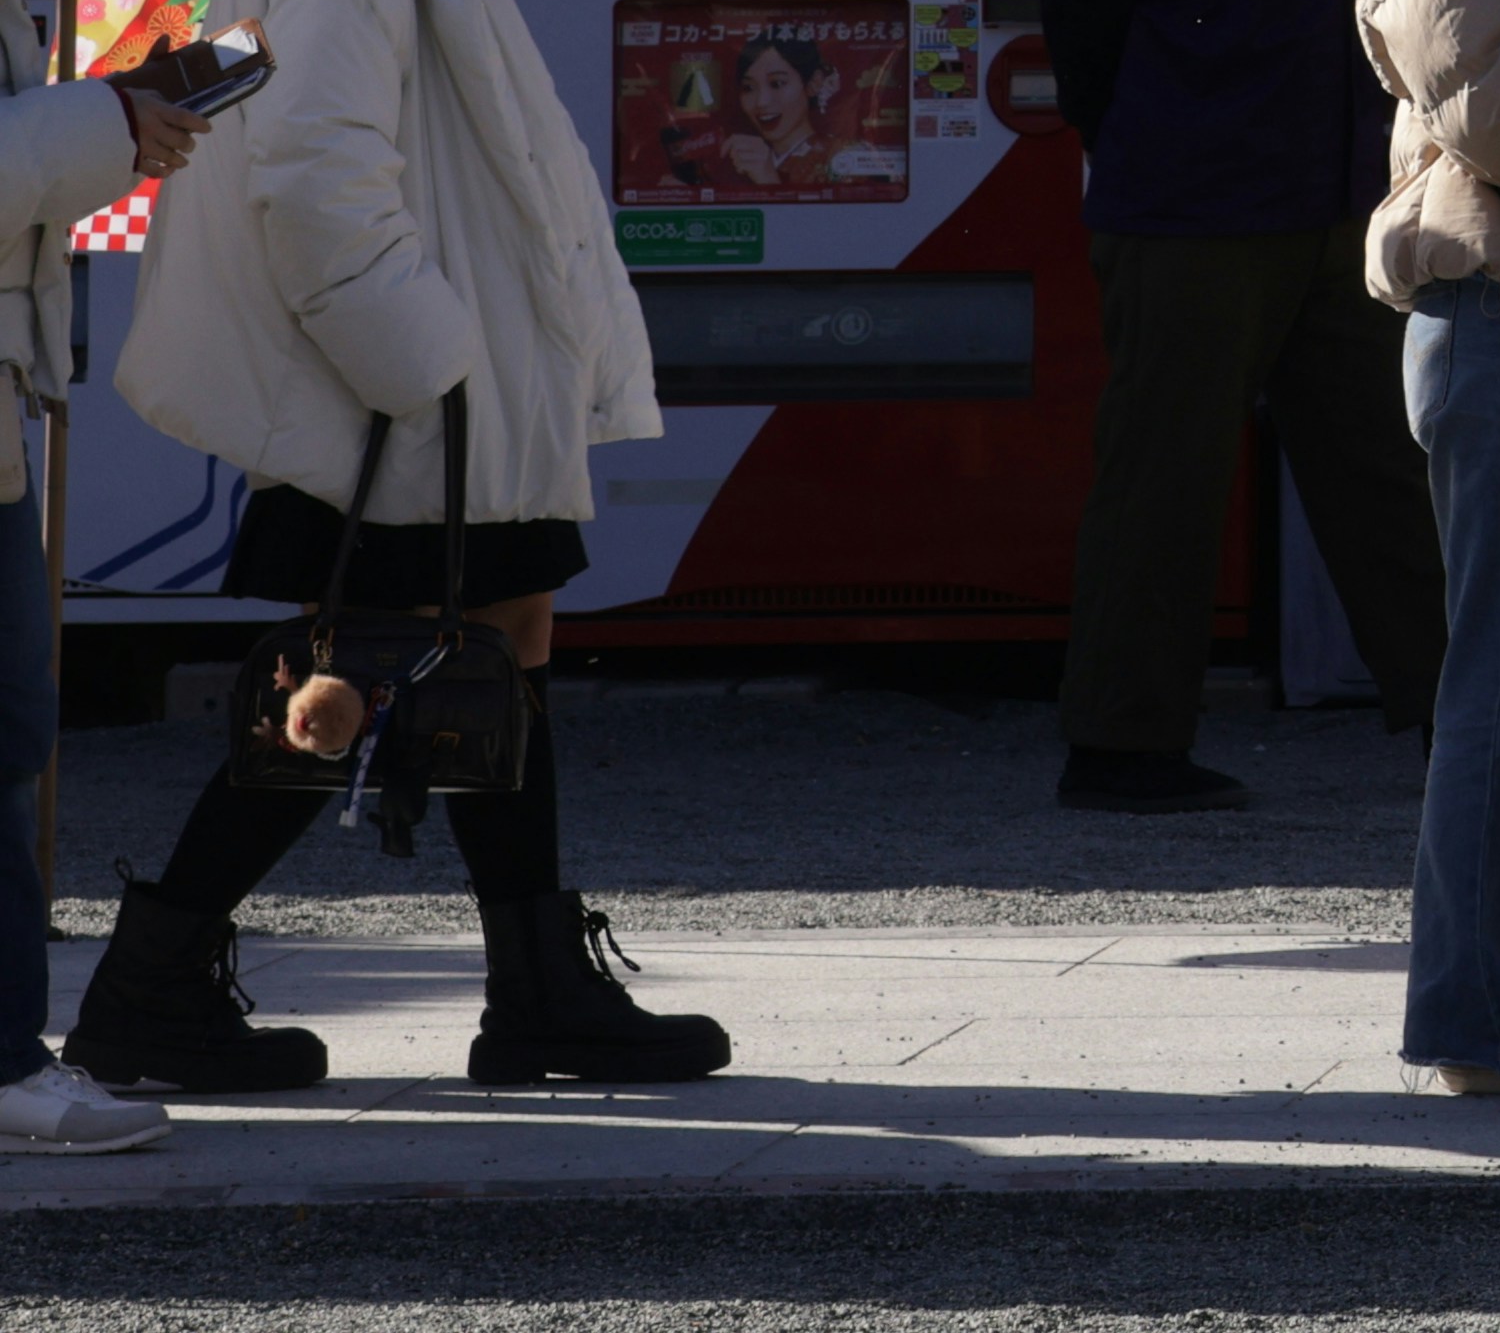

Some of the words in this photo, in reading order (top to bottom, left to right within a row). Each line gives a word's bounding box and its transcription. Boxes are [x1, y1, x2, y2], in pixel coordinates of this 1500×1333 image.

[664, 21, 906, 42] コカ・コーラ1本必ずもらえる
